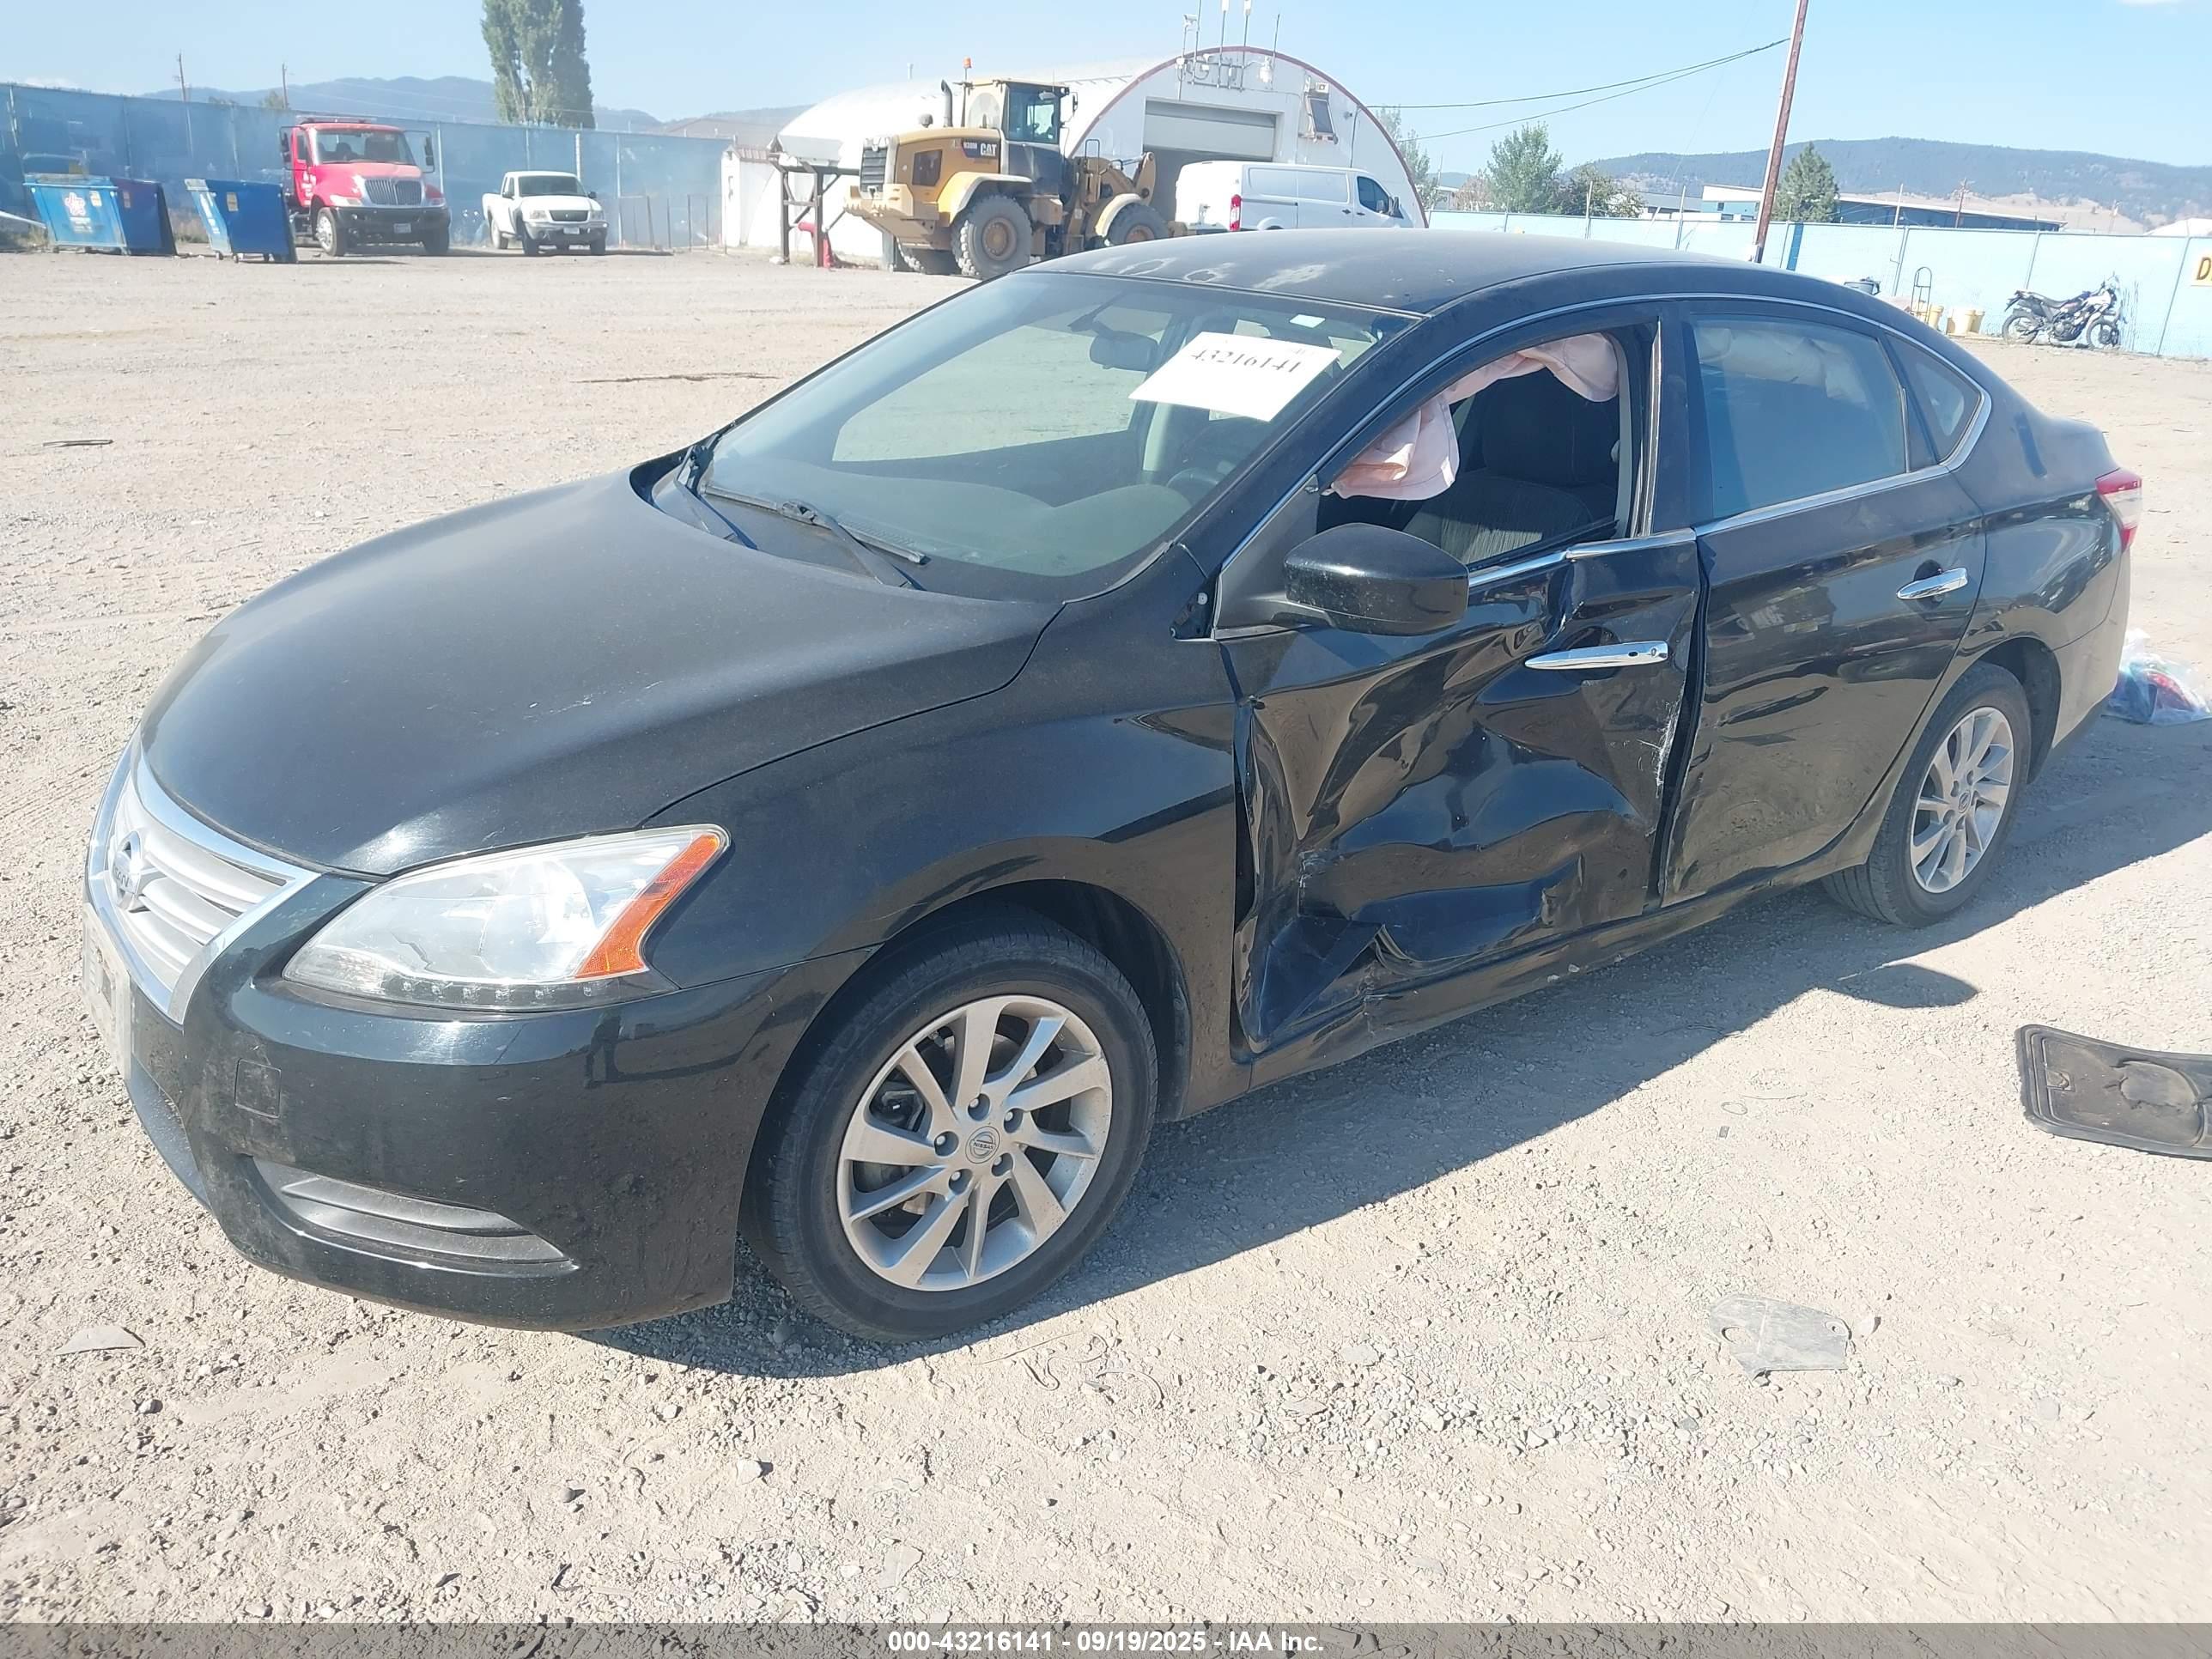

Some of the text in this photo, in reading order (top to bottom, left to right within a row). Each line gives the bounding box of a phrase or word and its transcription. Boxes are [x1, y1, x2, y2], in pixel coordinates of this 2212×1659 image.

[980, 143, 997, 156] CAT
[2196, 256, 2212, 281] D
[1191, 349, 1301, 372] 43216141
